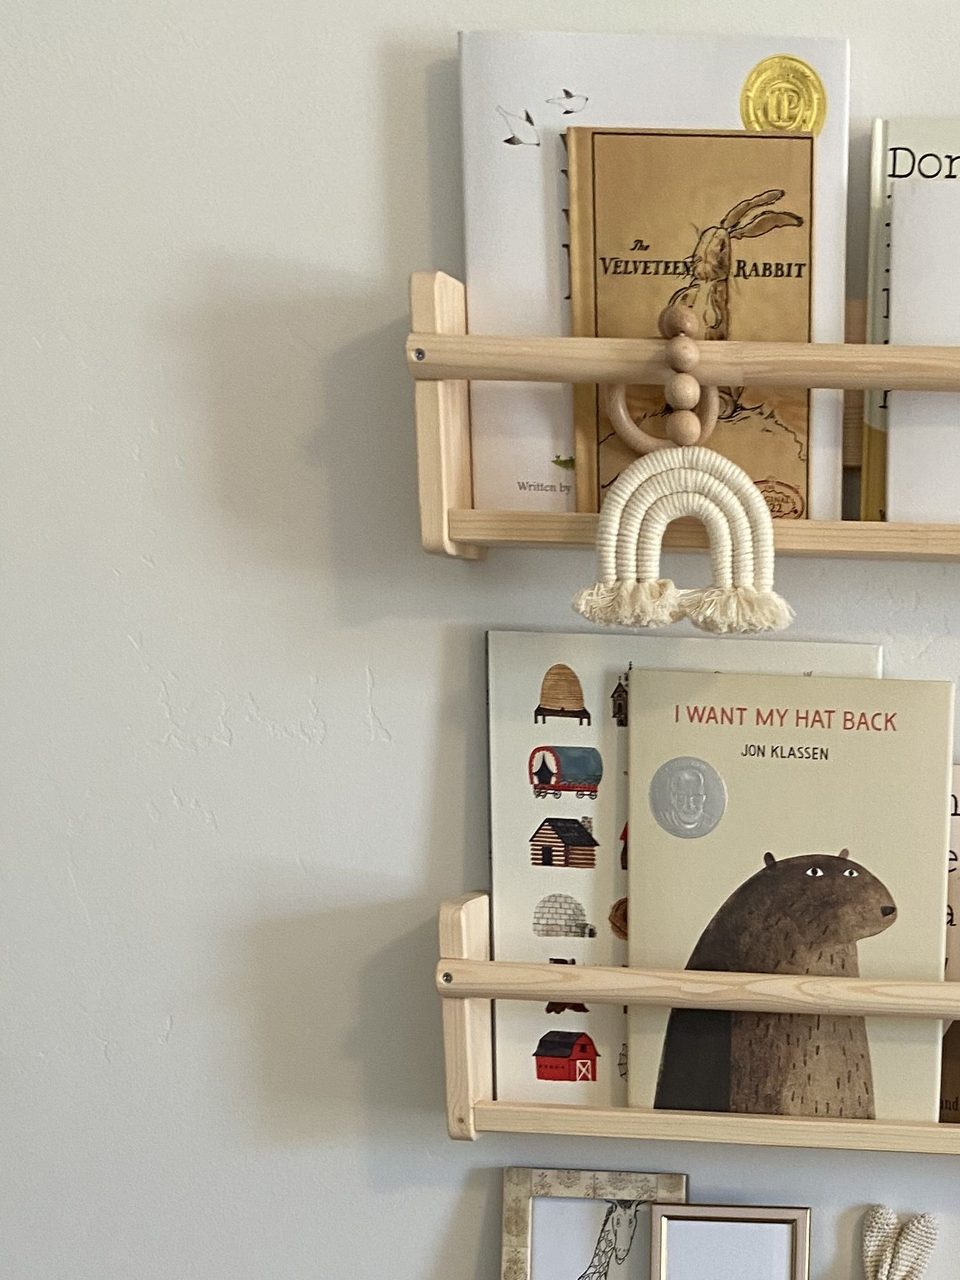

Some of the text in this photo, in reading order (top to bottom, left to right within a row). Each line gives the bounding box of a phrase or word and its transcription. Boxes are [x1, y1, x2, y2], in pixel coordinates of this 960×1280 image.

[630, 239, 650, 251] The
[734, 259, 806, 280] RABBIT
[517, 481, 573, 495] Written by
[674, 704, 898, 732] I WANT MY HAT BACK
[741, 744, 829, 760] JON KLASSEN
